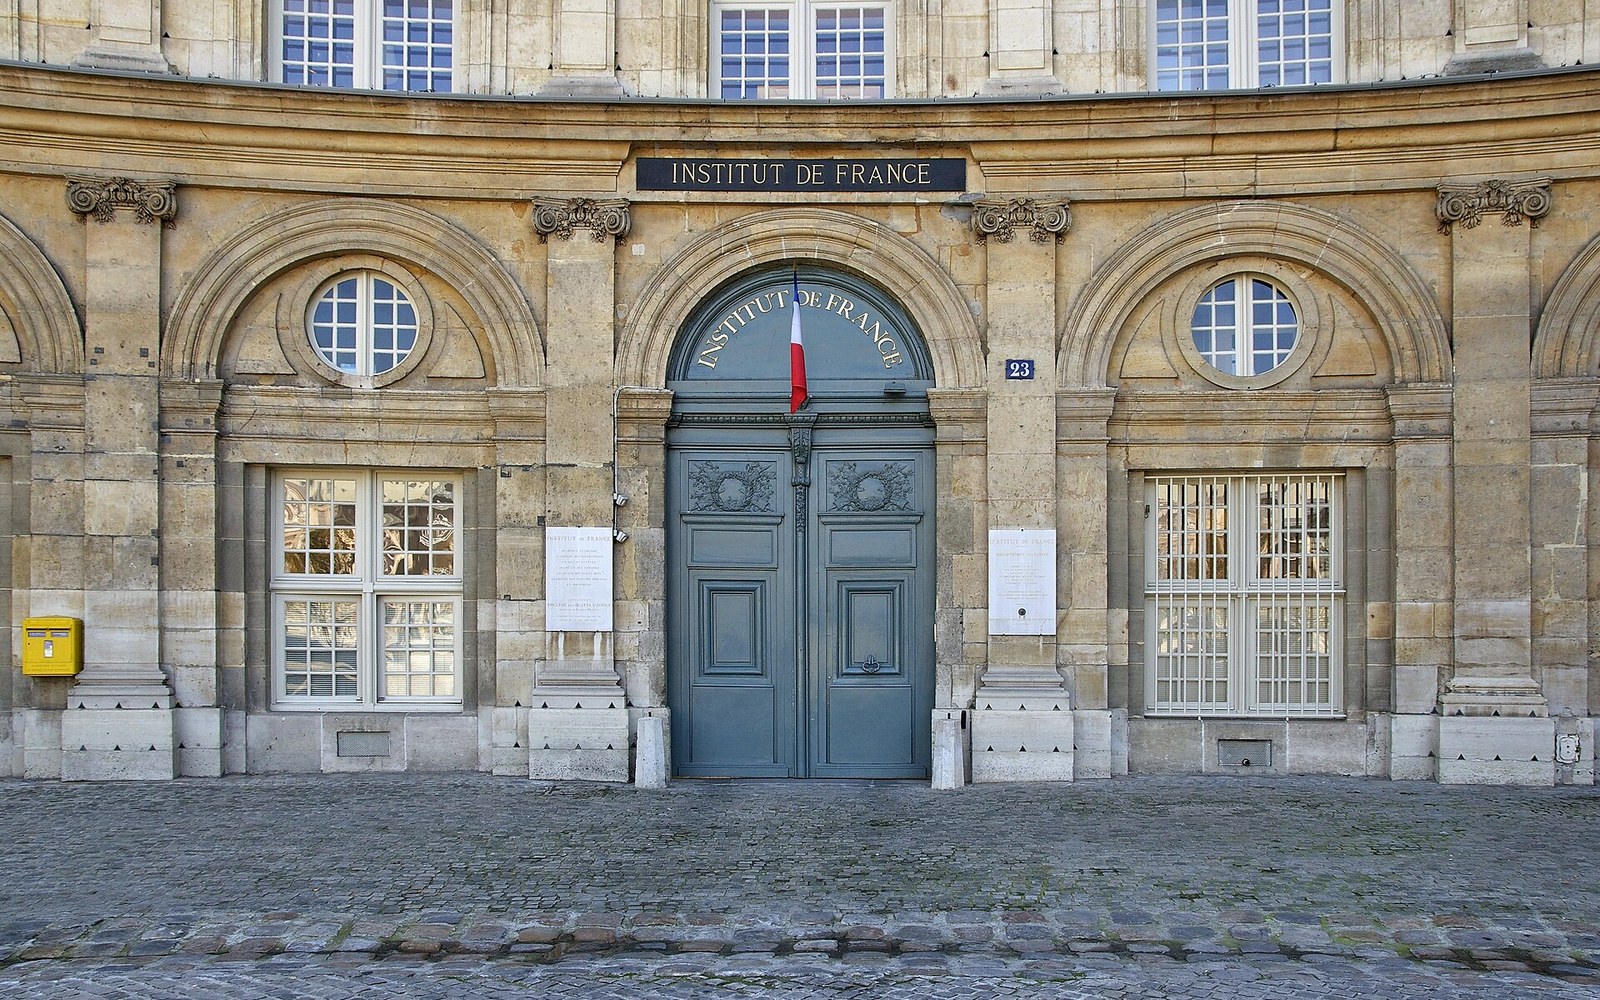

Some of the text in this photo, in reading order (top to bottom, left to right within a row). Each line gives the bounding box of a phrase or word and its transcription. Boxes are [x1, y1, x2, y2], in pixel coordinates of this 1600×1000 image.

[672, 162, 932, 185] INSTITUT DE FRANCE
[698, 289, 903, 369] INSTITUT DE FRANCE
[1010, 362, 1030, 377] 23
